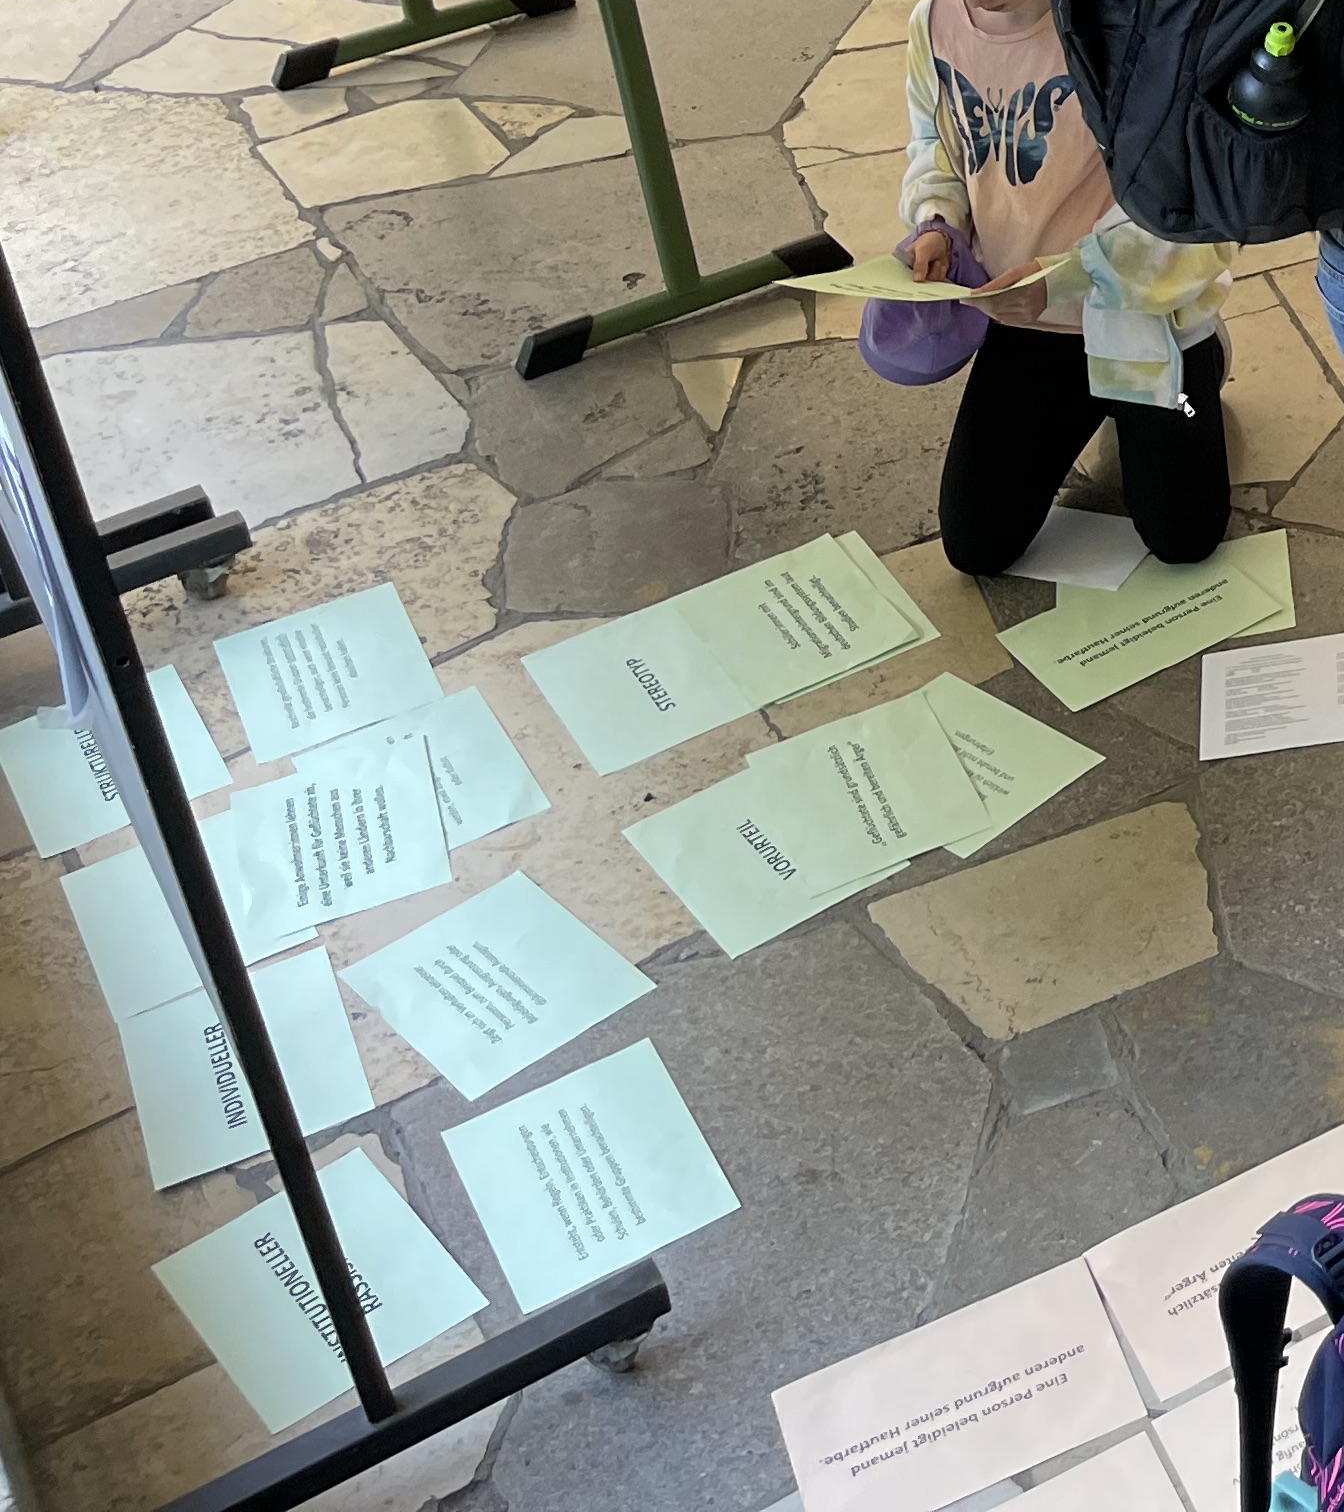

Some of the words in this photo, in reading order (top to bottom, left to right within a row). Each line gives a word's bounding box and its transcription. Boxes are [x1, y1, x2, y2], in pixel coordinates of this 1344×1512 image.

[1188, 579, 1228, 600] anderen
[1200, 595, 1222, 606] Eine
[1142, 600, 1186, 624] aufgrund
[1165, 606, 1200, 624] Person
[1111, 622, 1140, 639] seiner
[1120, 623, 1165, 646] beleidigt
[1057, 638, 1109, 664] Hautfarbe.
[1080, 644, 1120, 666] jemand
[624, 656, 677, 713] STEREOTYP
[861, 762, 880, 792] bereiten
[847, 789, 863, 804] sind
[872, 790, 887, 804] und
[736, 818, 798, 881] VORURTEIL
[203, 1020, 249, 1130] INDIVIDUELLER
[1025, 1345, 1084, 1375] anderen
[954, 1373, 1020, 1410] aufgrund
[1036, 1373, 1068, 1391] Eine
[982, 1389, 1032, 1416] Person
[905, 1404, 950, 1430] seiner
[912, 1414, 979, 1448] beleidigt
[819, 1427, 900, 1464] Hautfarbe.
[851, 1441, 909, 1477] jemand
